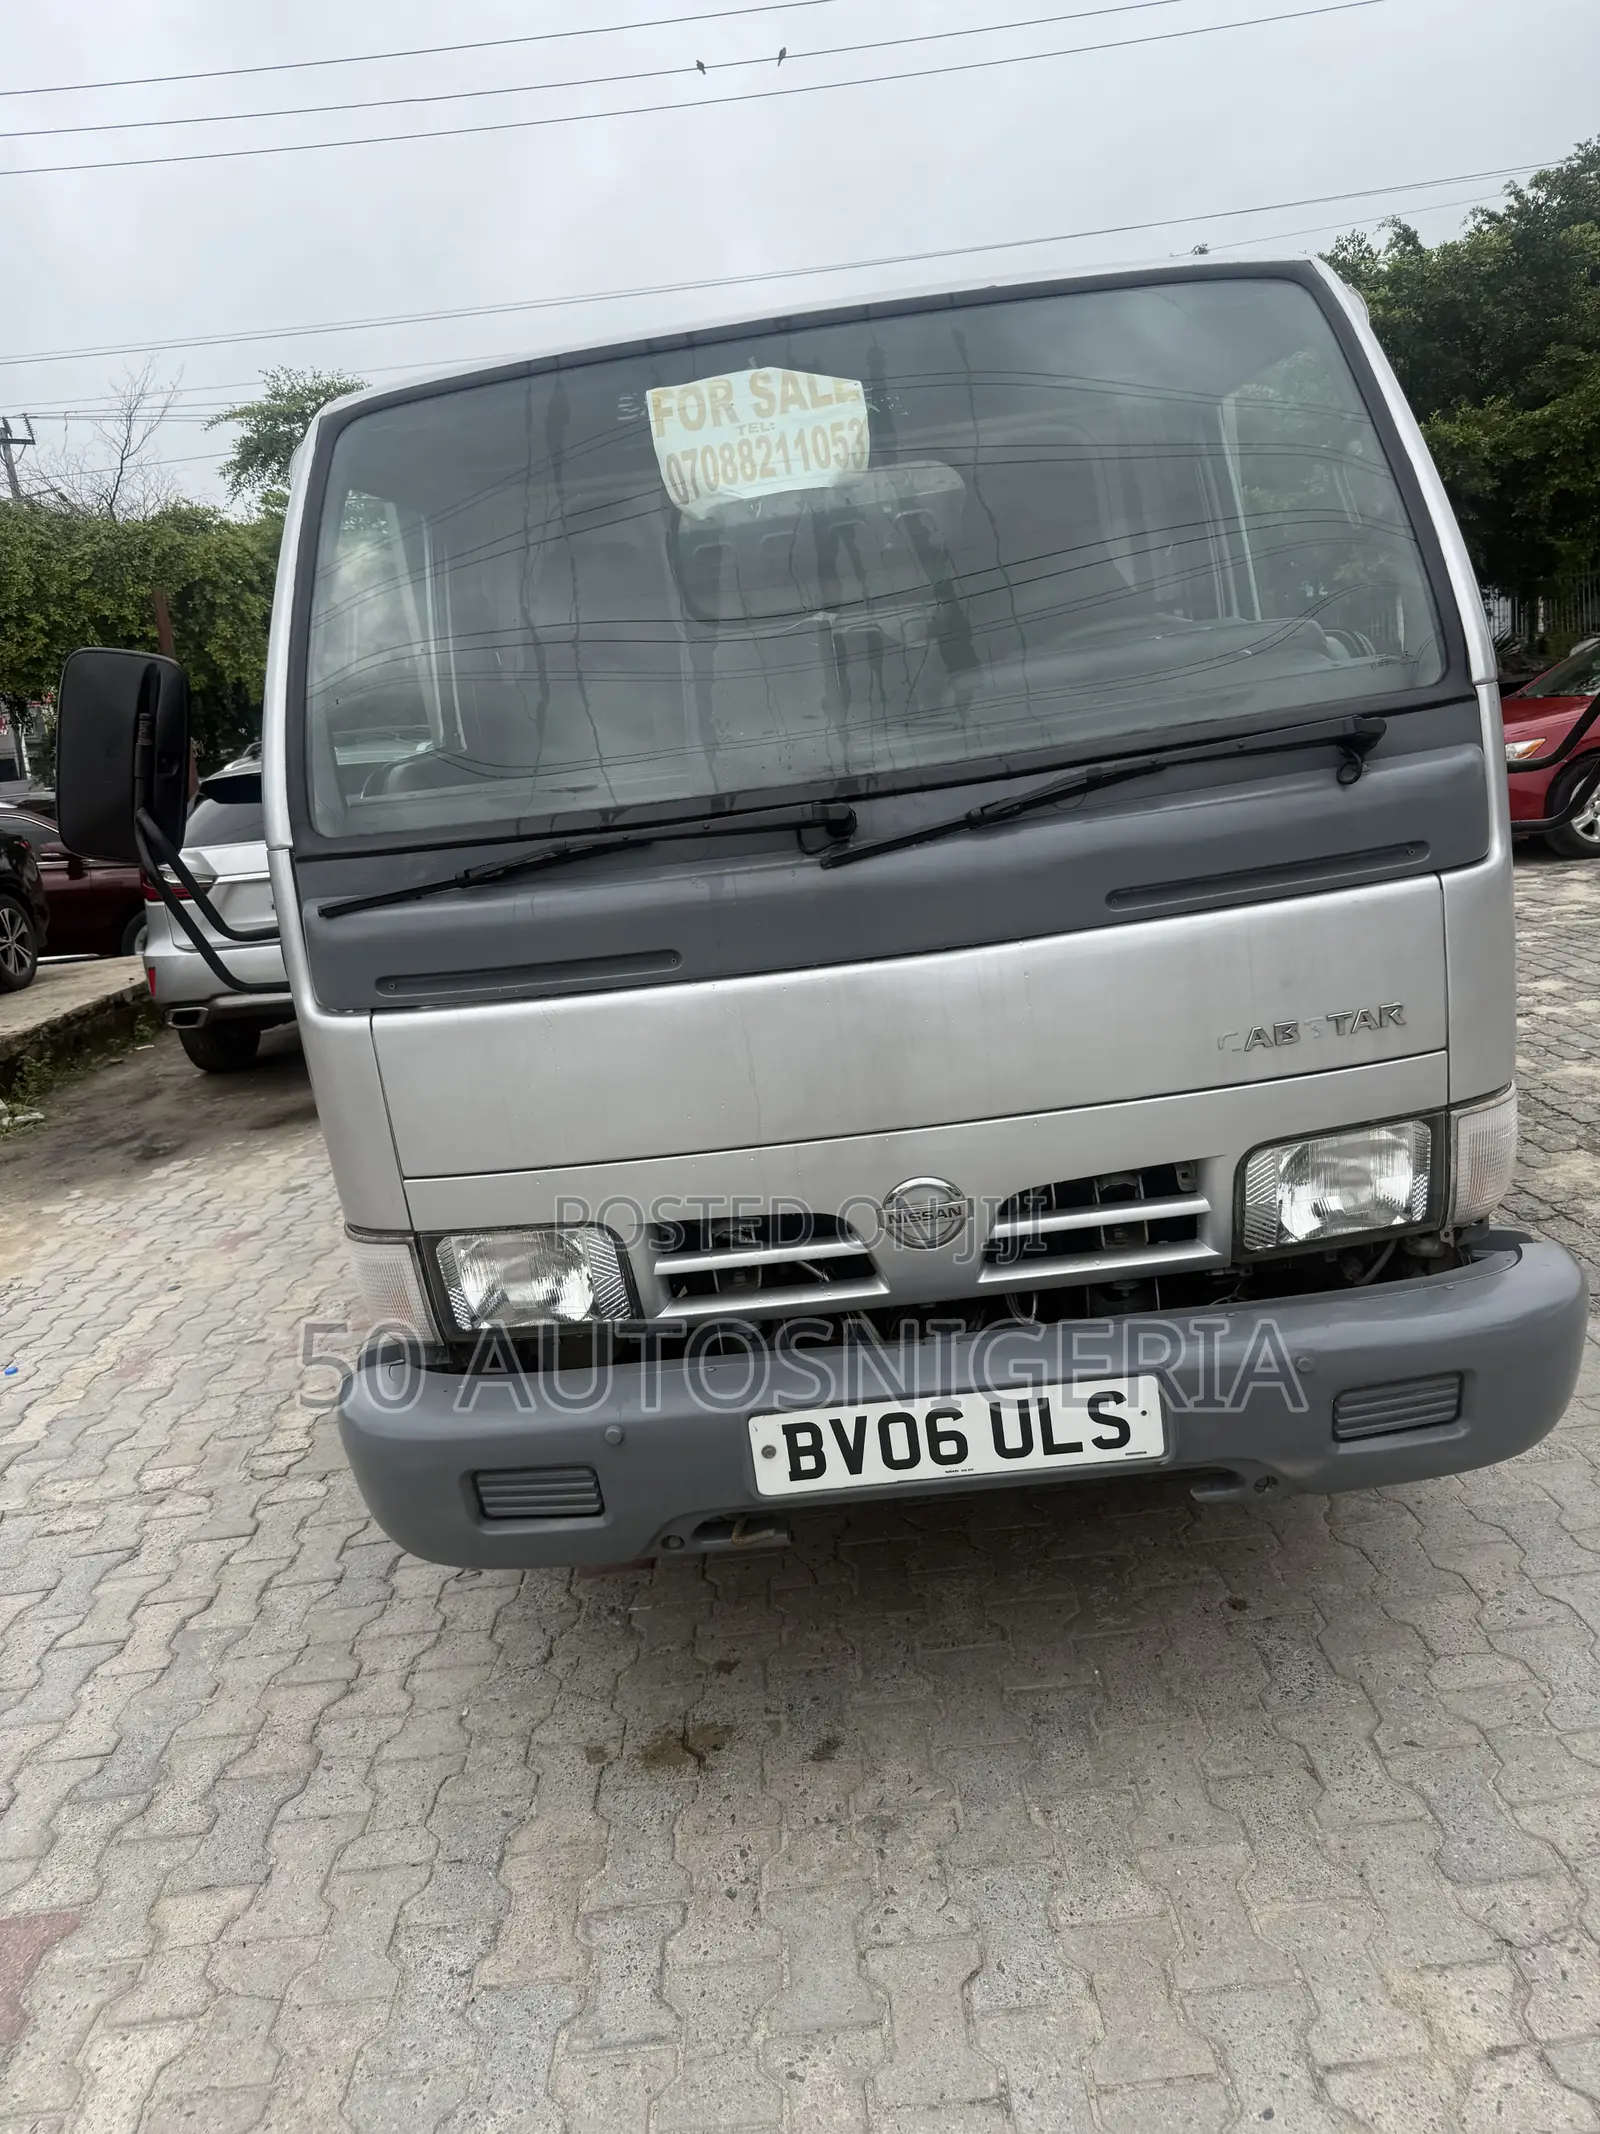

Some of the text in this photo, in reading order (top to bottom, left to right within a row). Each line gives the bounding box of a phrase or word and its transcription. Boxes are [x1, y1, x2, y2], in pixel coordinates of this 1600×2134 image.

[651, 370, 861, 439] FOR SALE
[735, 421, 777, 436] TEL:
[665, 417, 867, 506] 07088211053
[1216, 1001, 1407, 1052] ABTAR
[888, 1205, 962, 1225] NISSAN
[781, 1390, 1131, 1482] BV06 ULS
